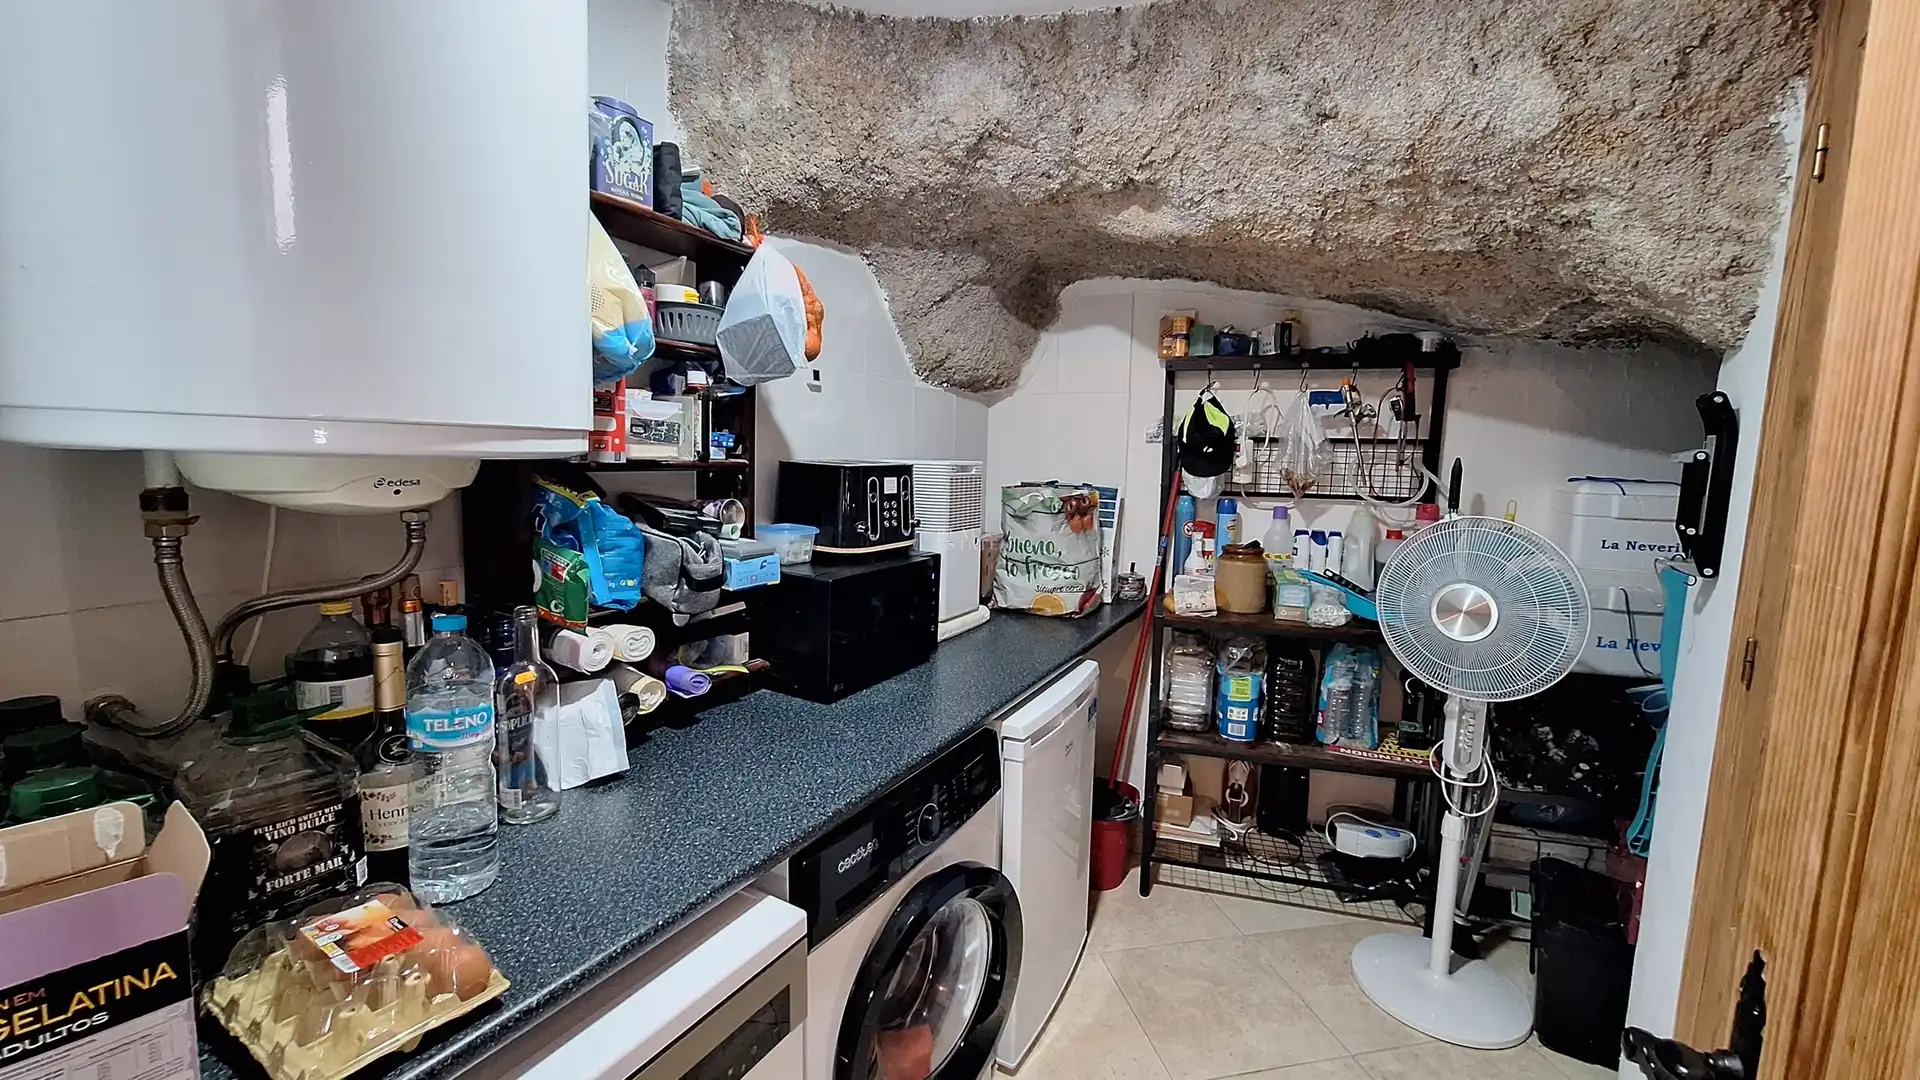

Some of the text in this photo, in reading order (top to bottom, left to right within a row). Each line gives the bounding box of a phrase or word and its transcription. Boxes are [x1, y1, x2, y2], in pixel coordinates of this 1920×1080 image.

[605, 159, 650, 195] SUGAR
[387, 478, 421, 487] edesa
[1600, 539, 1681, 553] La Neveri
[1596, 636, 1661, 652] La Nev
[423, 711, 488, 732] TELENO
[253, 803, 343, 836] FULL RICH SWEET WINE
[264, 812, 336, 841] VINO DULCE
[265, 867, 313, 892] FORTE
[314, 856, 344, 876] MAR
[0, 961, 178, 1042] GELATINA
[14, 988, 46, 1007] EM
[0, 1011, 110, 1059] DULTOS
